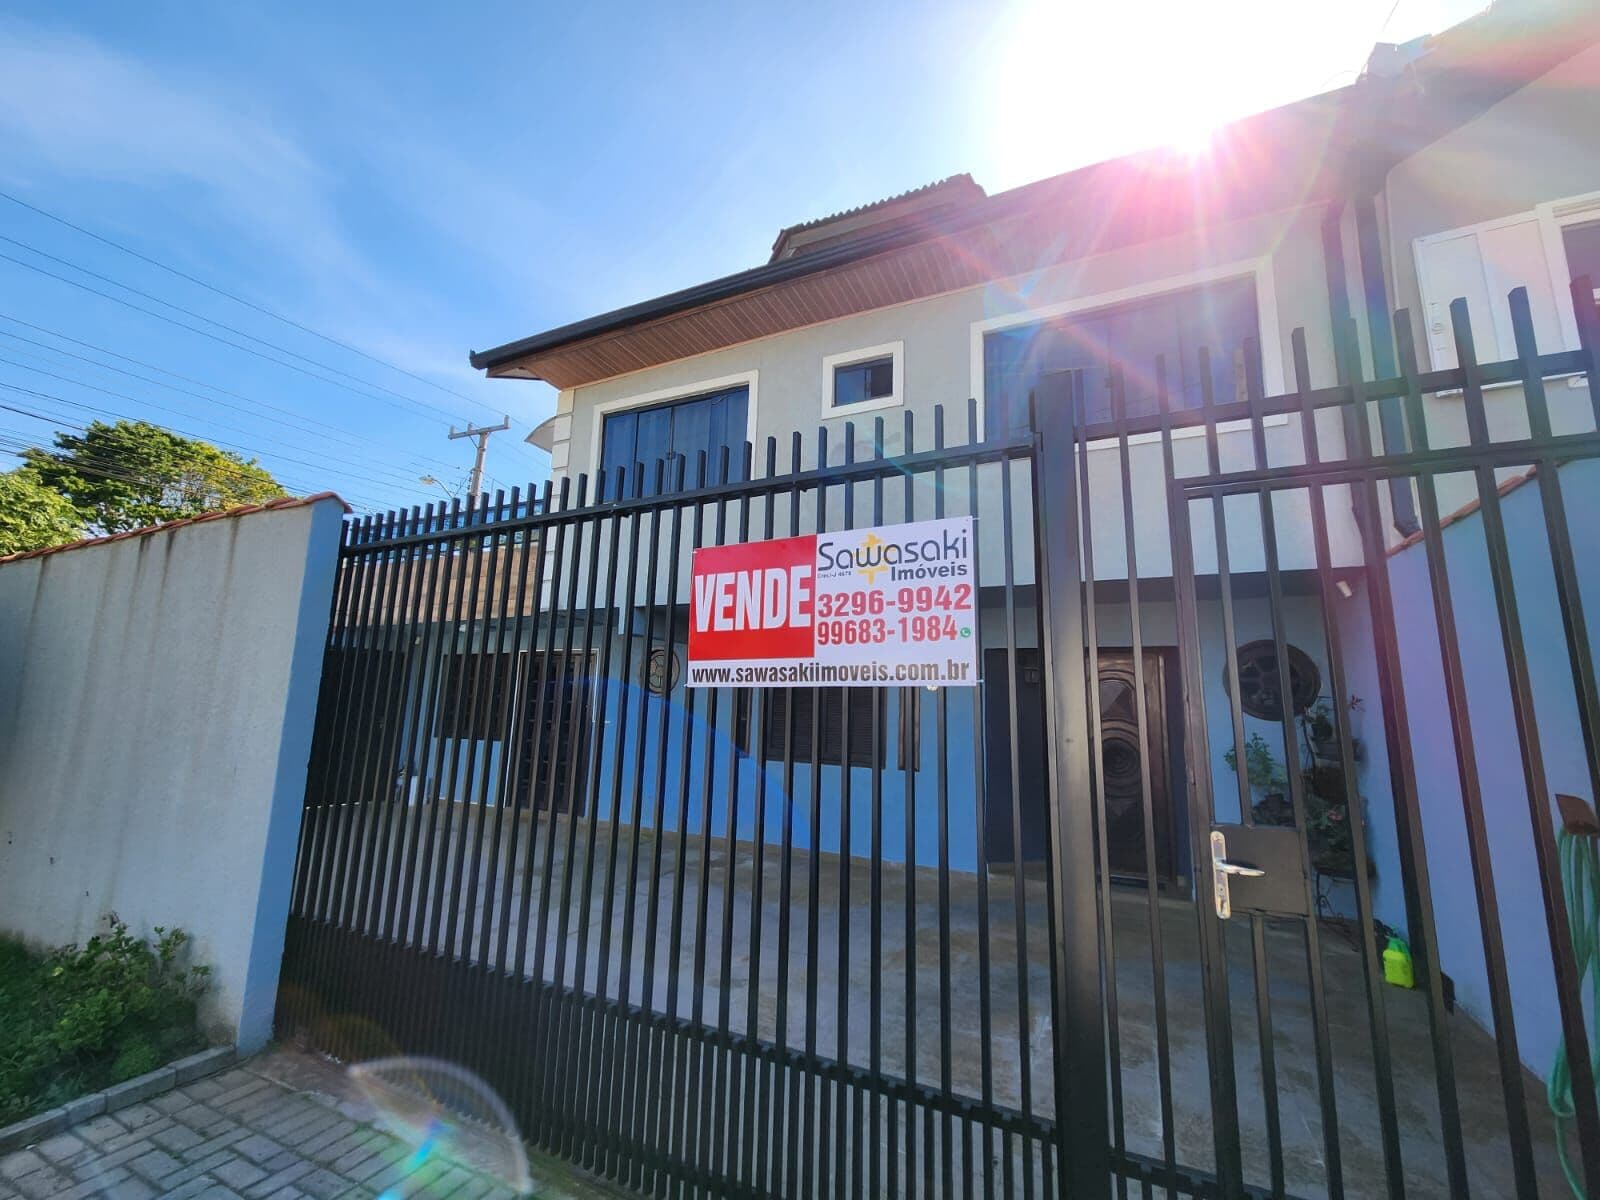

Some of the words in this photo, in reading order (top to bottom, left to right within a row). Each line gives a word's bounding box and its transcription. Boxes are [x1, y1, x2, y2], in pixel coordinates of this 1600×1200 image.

[817, 529, 968, 571] Sawasaki
[891, 562, 968, 582] Imóveis
[694, 564, 811, 633] VENDE
[818, 583, 972, 617] 3296-9942
[817, 614, 958, 645] 99683-1984
[692, 659, 969, 683] www.sawasakiimoveis.com.br
